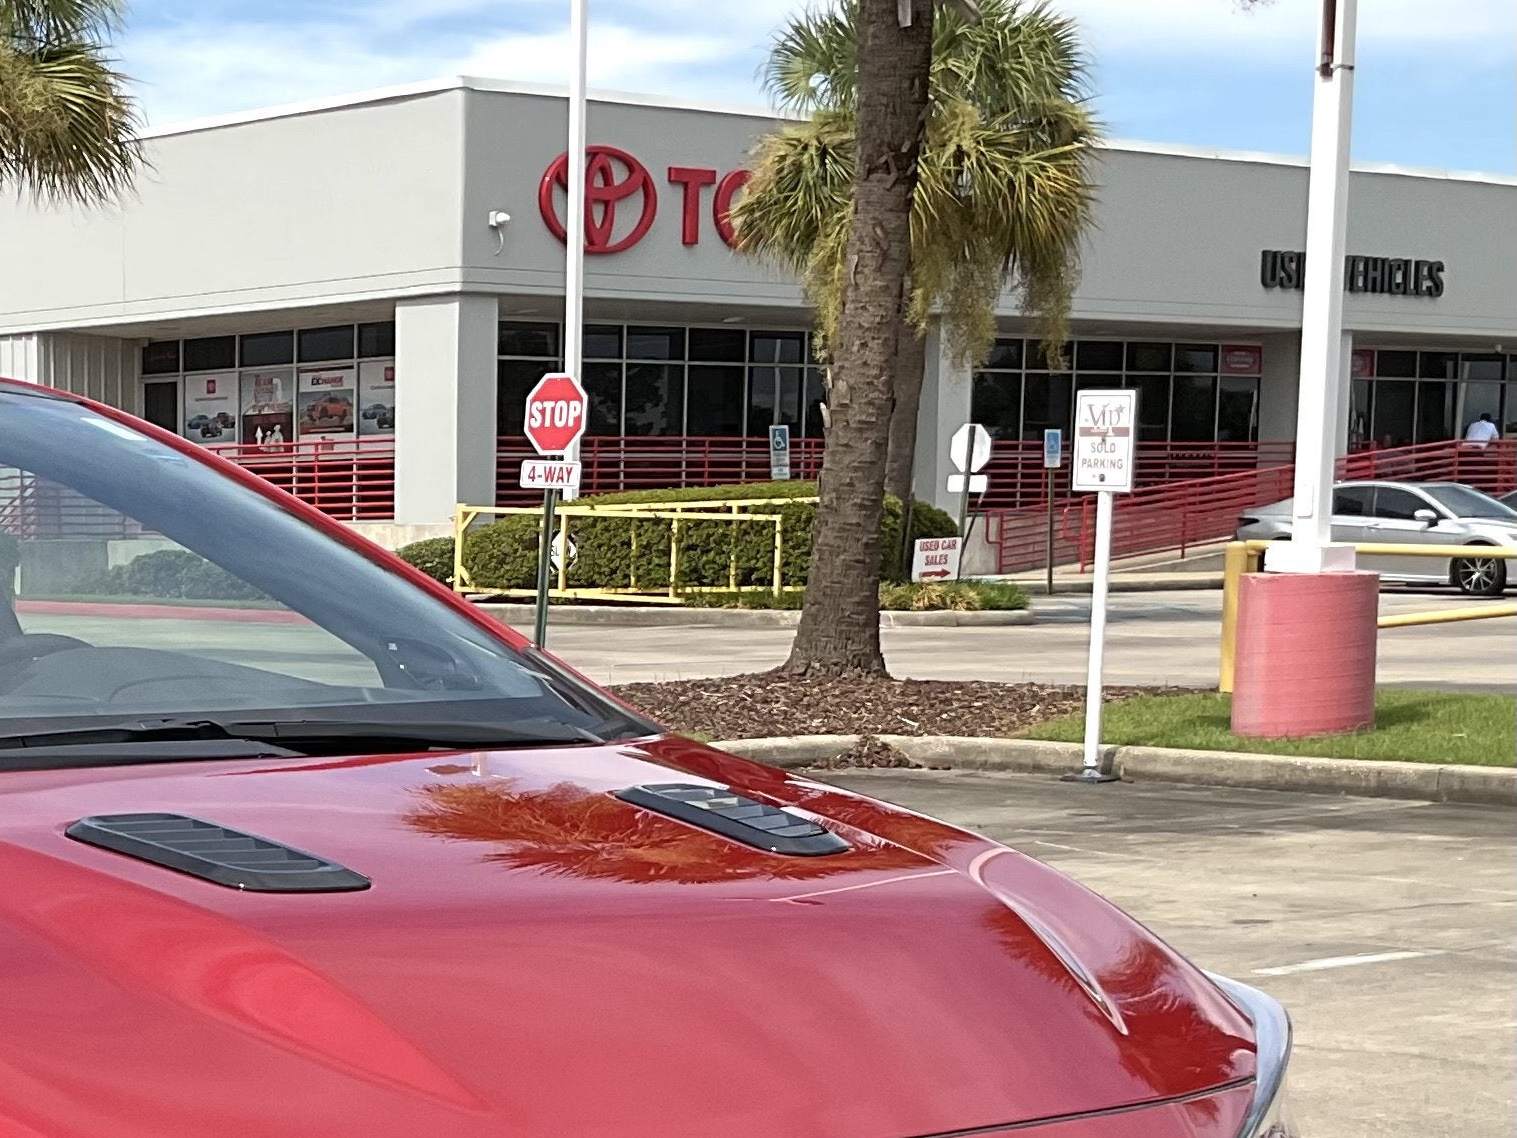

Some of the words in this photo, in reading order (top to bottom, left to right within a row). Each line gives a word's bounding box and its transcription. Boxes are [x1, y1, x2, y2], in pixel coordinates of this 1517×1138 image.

[530, 400, 582, 428] STOP
[1090, 442, 1116, 453] SOLD
[1082, 458, 1123, 469] PARKING
[528, 465, 573, 483] 4-WAY
[919, 541, 939, 552] USED
[942, 540, 957, 550] CAR
[925, 554, 948, 566] SALES
